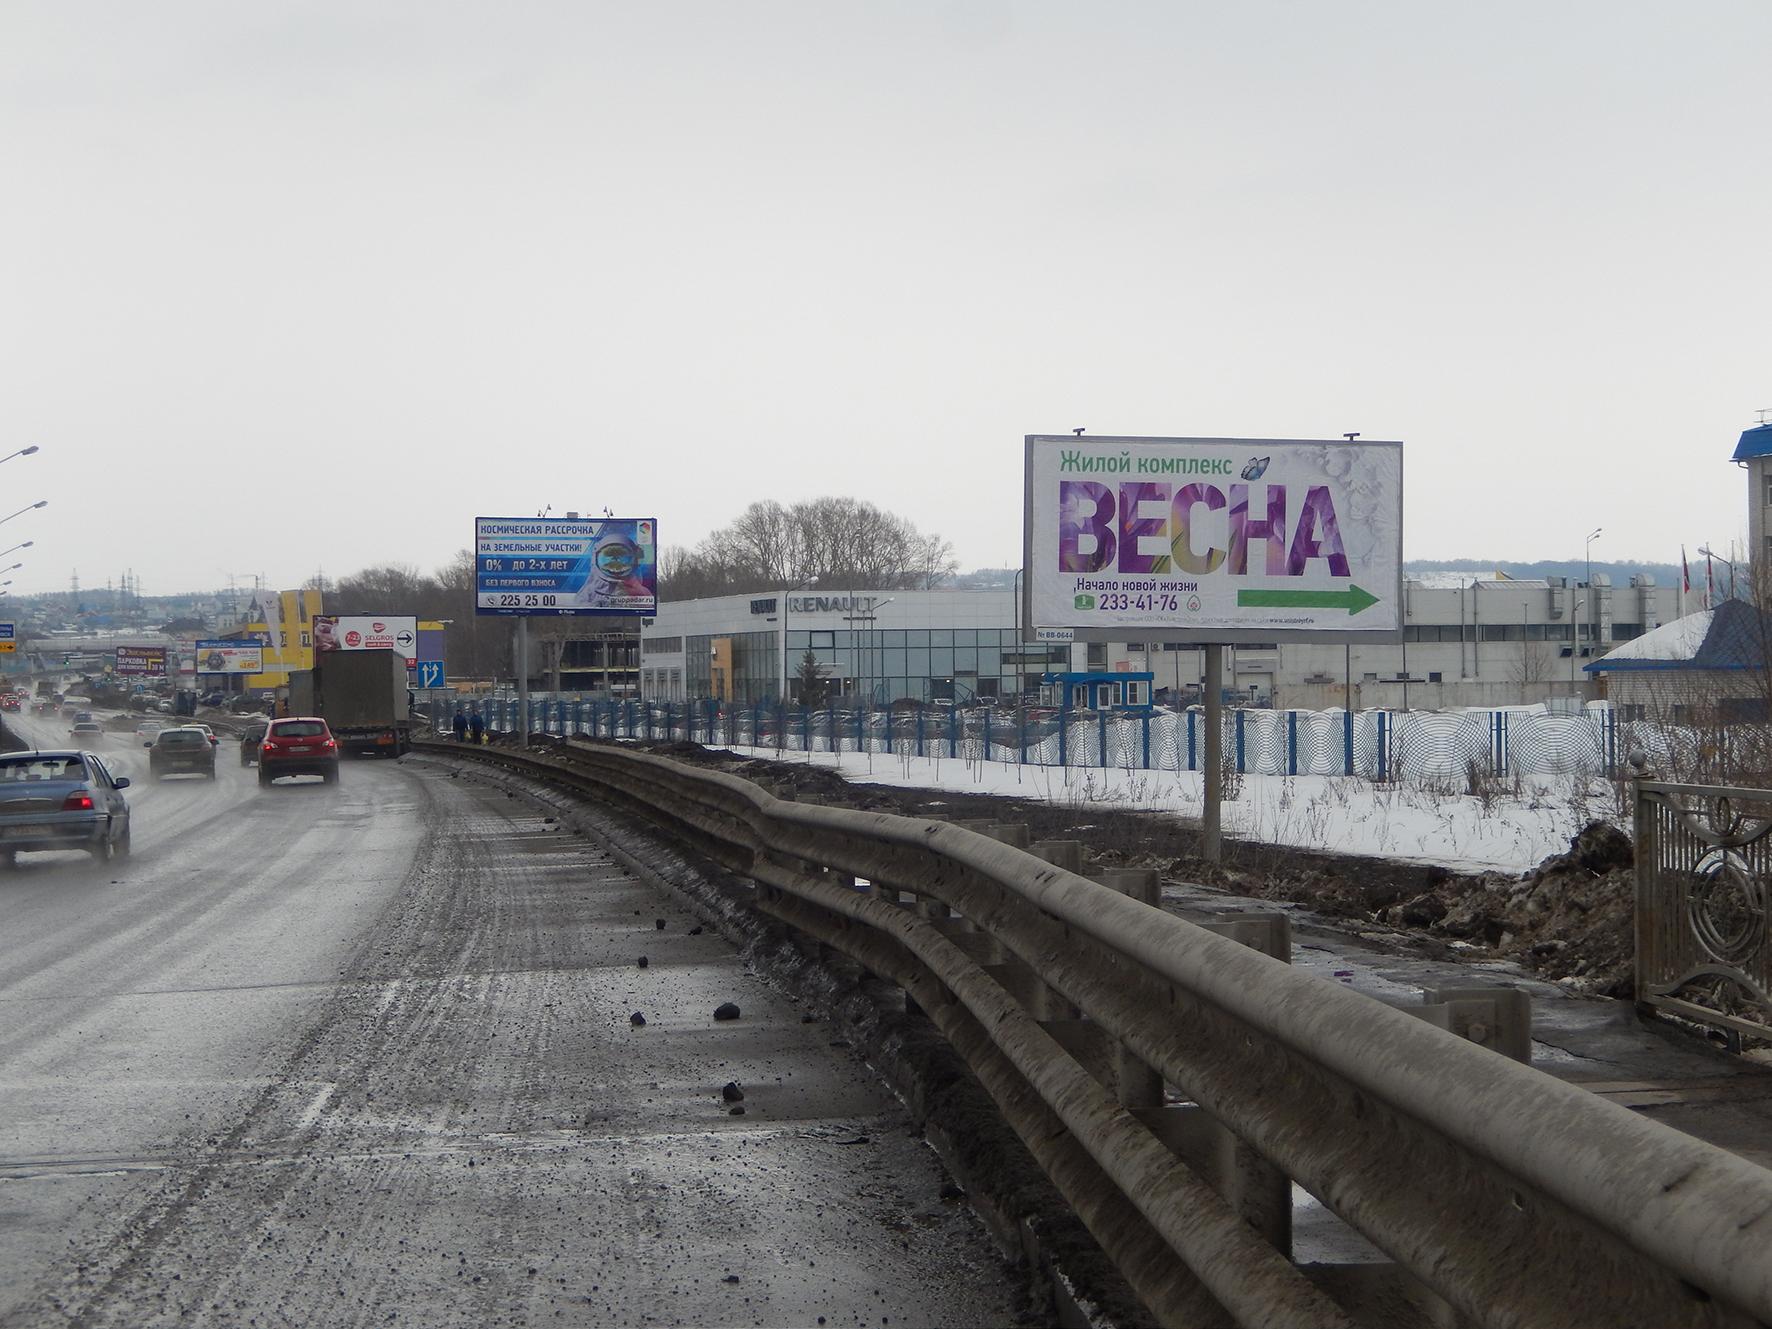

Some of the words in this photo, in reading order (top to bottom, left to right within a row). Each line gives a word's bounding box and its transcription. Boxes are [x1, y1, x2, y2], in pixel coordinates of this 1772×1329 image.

[1060, 450, 1131, 474] Жилой
[1138, 455, 1233, 475] комплекс
[481, 525, 542, 535] КОСМИЧЕСКАЯ
[545, 525, 594, 535] РАССРОЧКА
[1059, 480, 1351, 577] ВЕСНА
[480, 543, 491, 552] НА
[494, 543, 542, 552] ЗЕМЕЛЬНЫЕ
[545, 543, 582, 552] УЧАСТКИ!
[485, 559, 502, 571] 0%
[512, 560, 525, 571] до
[529, 559, 547, 570] 2-х
[550, 560, 568, 570] лет
[1122, 579, 1157, 592] новой
[1160, 581, 1198, 592] жизни
[500, 595, 521, 607] 225
[525, 595, 538, 607] 25
[542, 595, 556, 607] 00
[788, 597, 877, 613] RENAULT
[1099, 594, 1178, 612] 233-41-76
